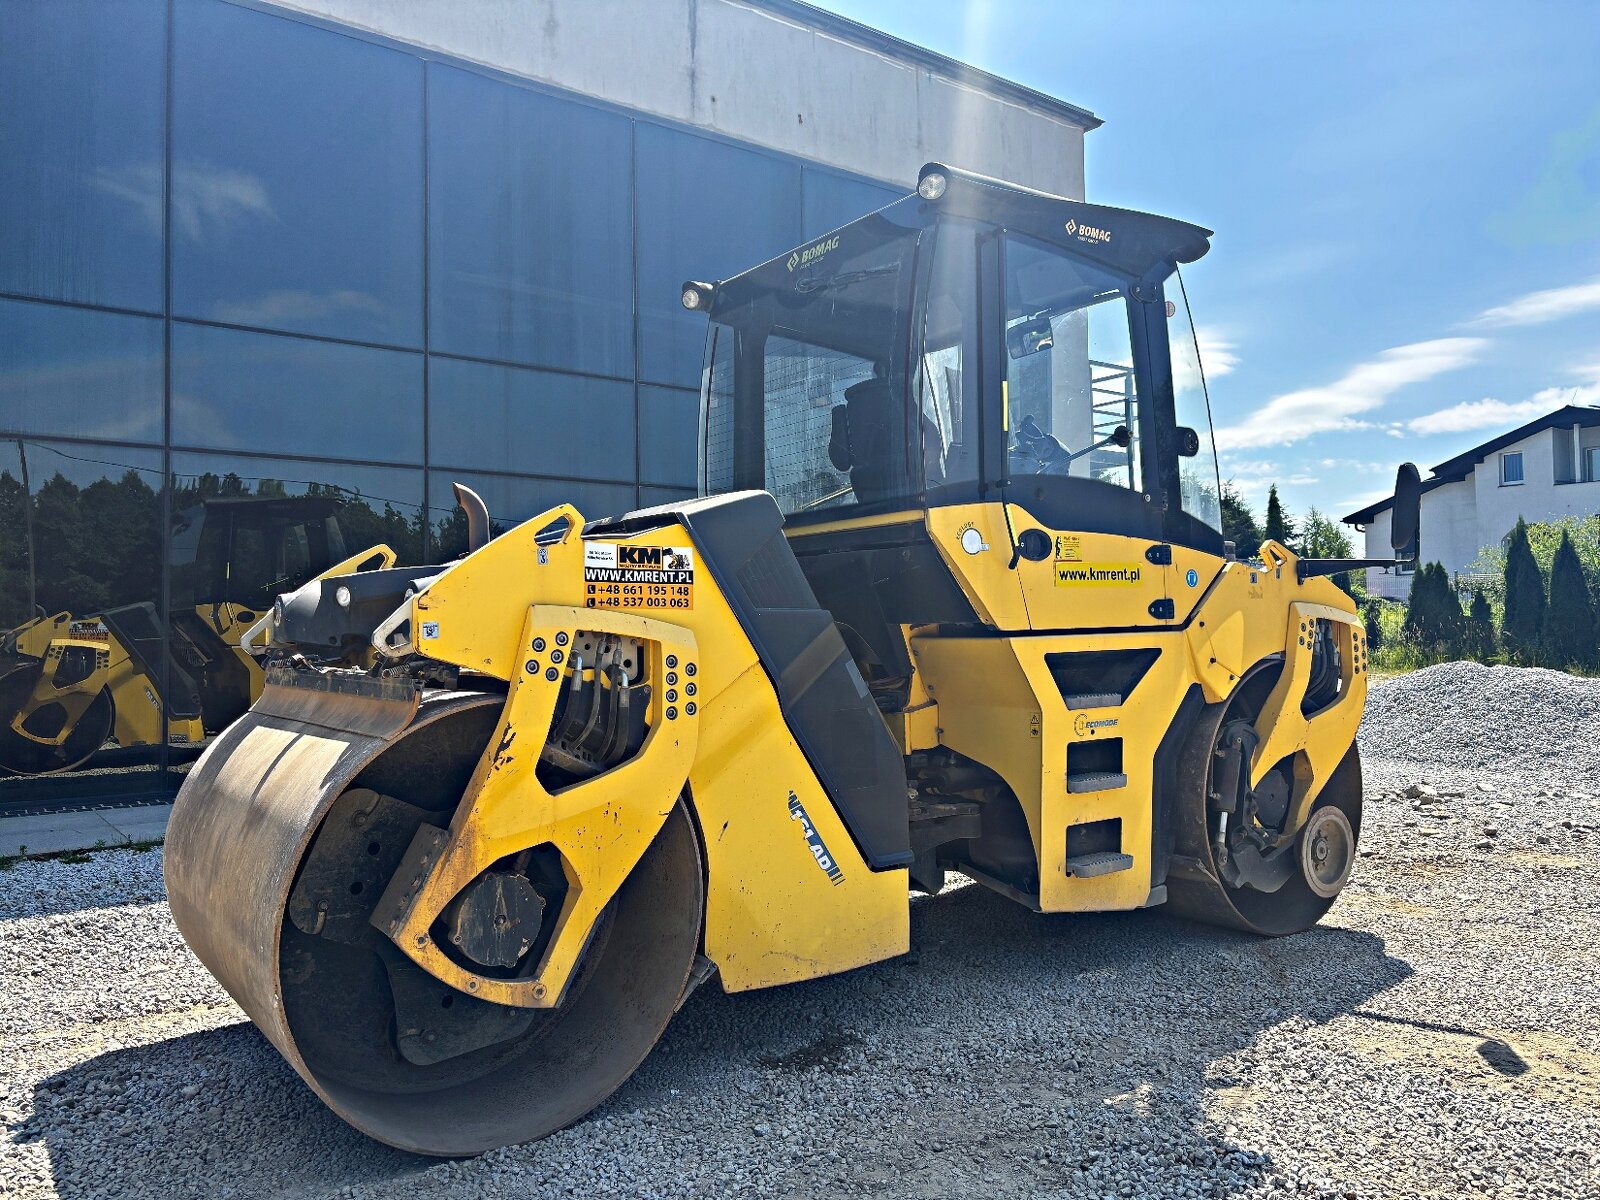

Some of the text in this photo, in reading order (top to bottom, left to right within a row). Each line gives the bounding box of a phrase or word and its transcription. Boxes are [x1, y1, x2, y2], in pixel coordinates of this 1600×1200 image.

[1079, 224, 1111, 242] BOMAG
[801, 236, 840, 263] BOMAG
[620, 547, 661, 564] KM
[585, 568, 692, 584] WWW.KMRENT.PL
[1059, 567, 1140, 583] www.kmrent.pl
[598, 585, 689, 596] +48 661 195 148
[598, 597, 689, 608] +48 537 003 063
[1086, 719, 1118, 728] ECOMODE
[808, 844, 831, 870] AD
